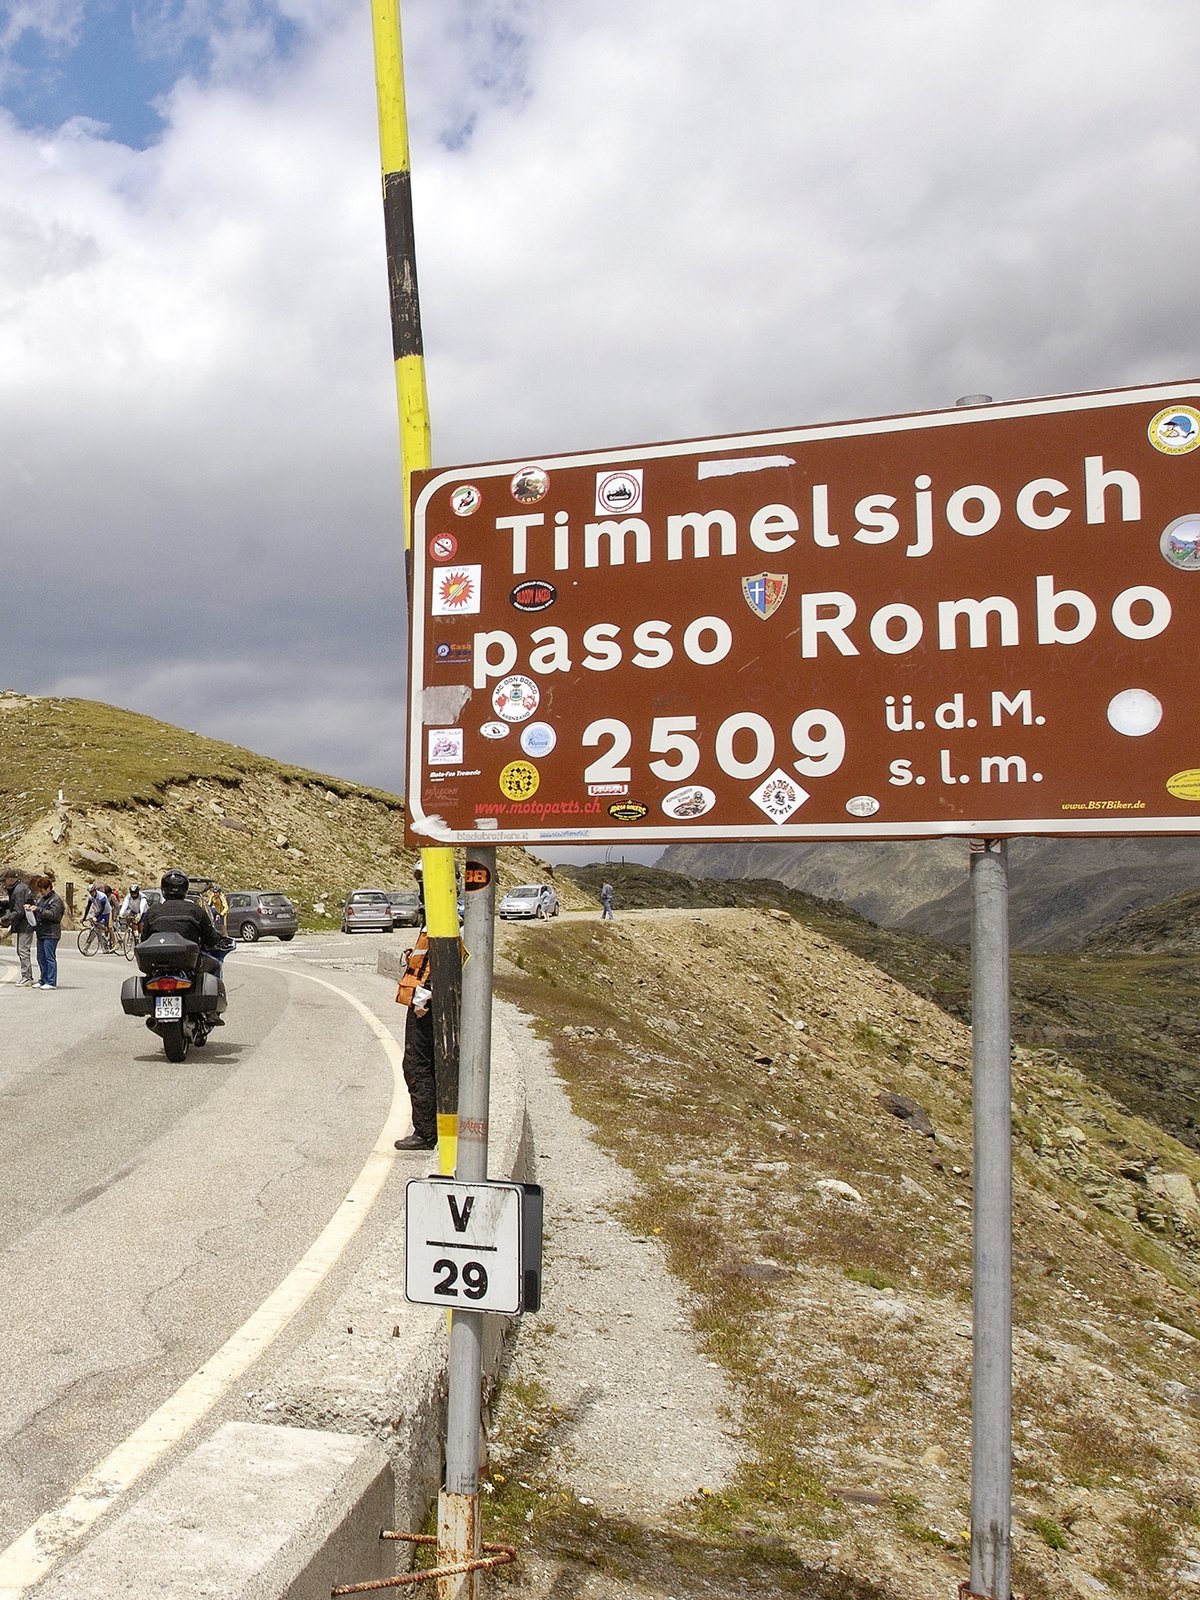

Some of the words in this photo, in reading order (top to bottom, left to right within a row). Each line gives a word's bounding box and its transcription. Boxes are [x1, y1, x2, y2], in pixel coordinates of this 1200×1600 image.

[495, 455, 1142, 575] Timmelsjoch
[473, 616, 733, 690] passo
[801, 574, 1172, 659] Rombo
[519, 676, 538, 695] BOSCO
[501, 710, 531, 721] ARENZANO
[581, 708, 846, 783] 2509
[474, 797, 602, 822] www.motoparts.ch
[765, 804, 793, 815] FAENZA
[1061, 800, 1146, 810] www.B57Biker.de
[162, 998, 173, 1007] KK
[446, 1194, 476, 1233] V
[432, 1258, 489, 1300] 29
